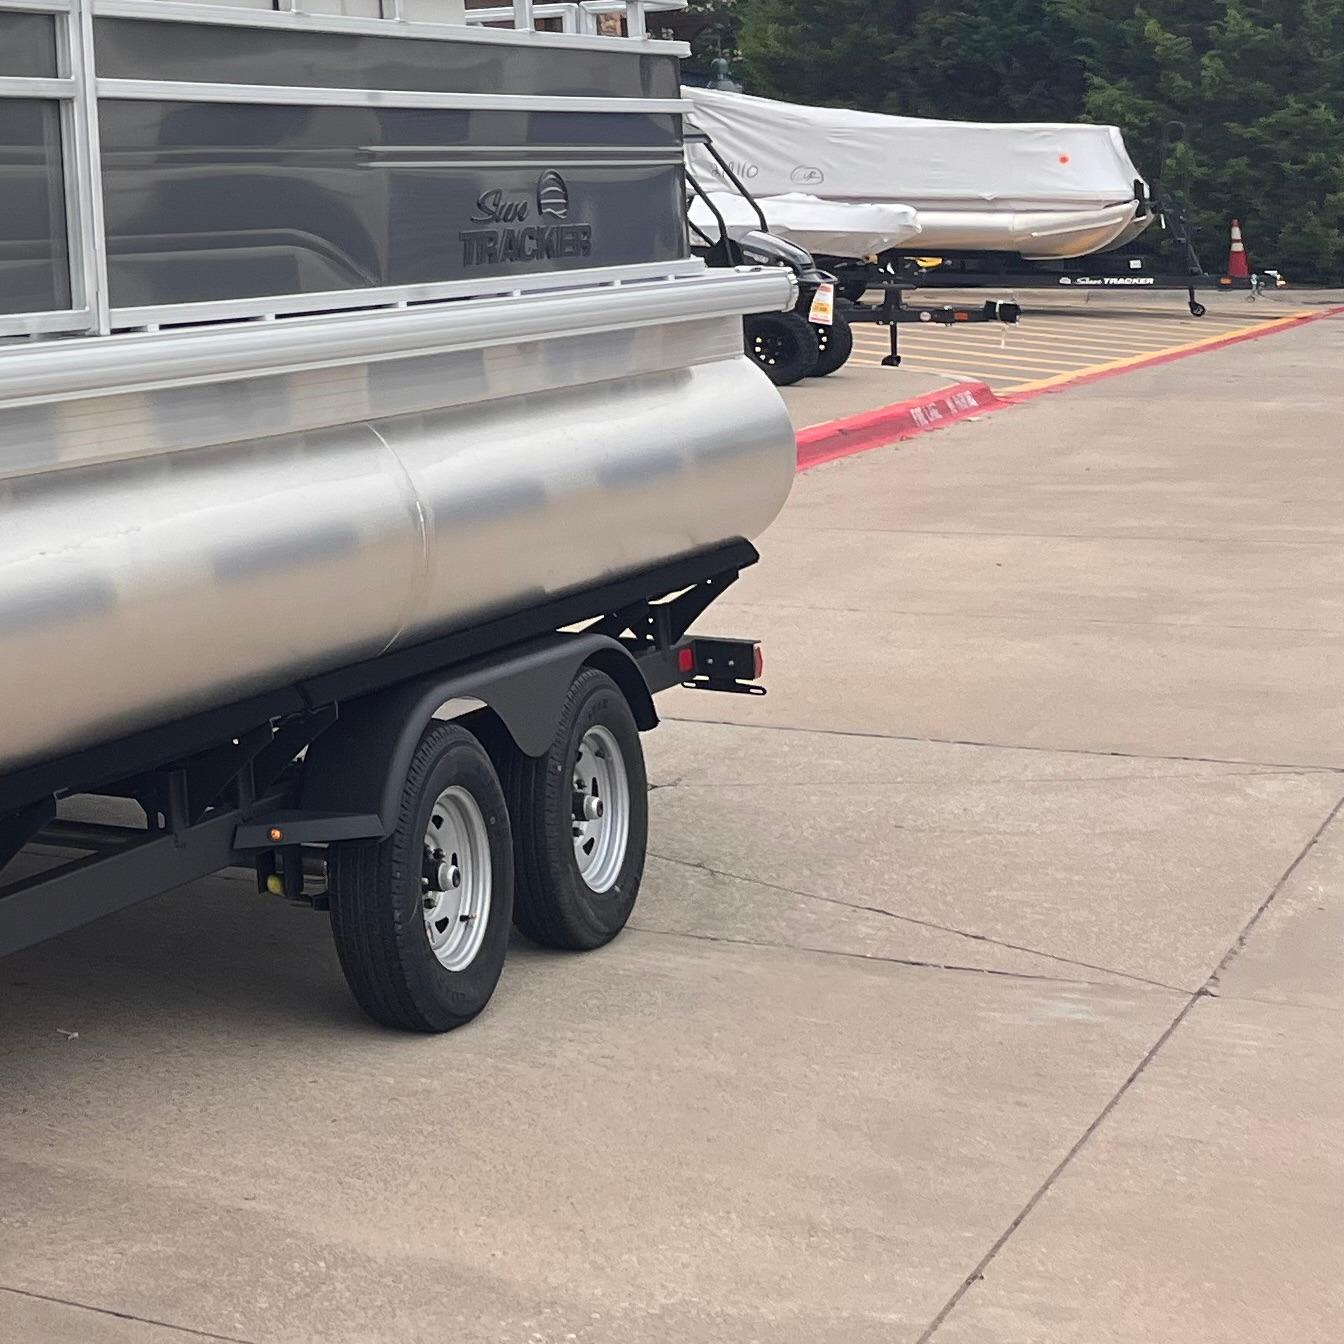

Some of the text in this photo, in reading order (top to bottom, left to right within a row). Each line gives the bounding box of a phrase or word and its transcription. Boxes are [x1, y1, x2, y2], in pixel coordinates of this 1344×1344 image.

[470, 188, 529, 223] Sun
[459, 222, 592, 267] TRACKER
[1103, 277, 1155, 285] TRACKER
